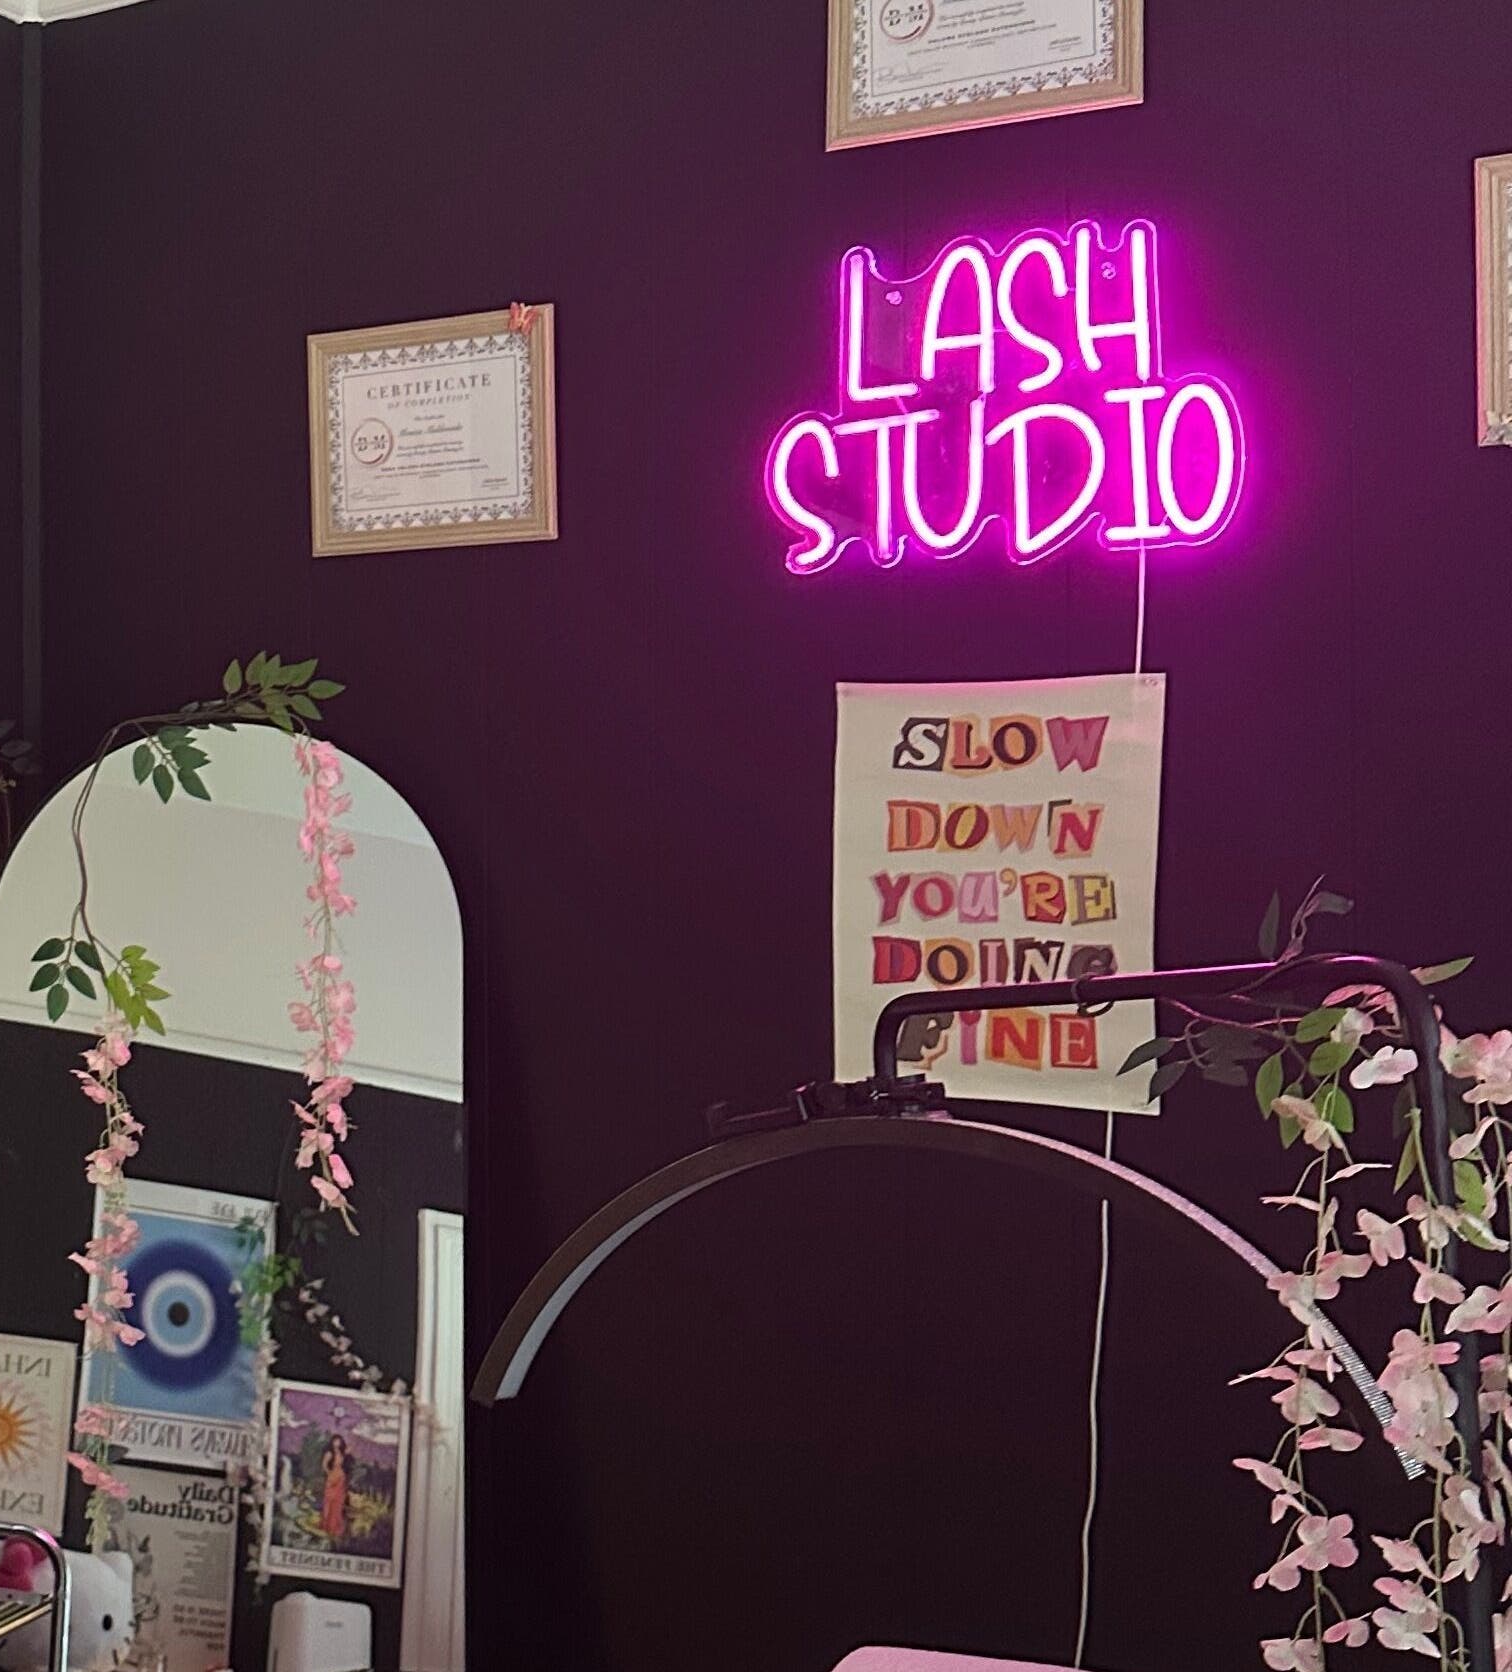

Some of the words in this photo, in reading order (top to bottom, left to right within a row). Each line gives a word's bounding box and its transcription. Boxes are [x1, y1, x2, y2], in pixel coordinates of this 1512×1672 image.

[848, 228, 1151, 401] LASH
[367, 373, 492, 400] CERTIFICATE
[773, 383, 1234, 566] STUDIO
[892, 715, 1110, 775] SLOW
[886, 800, 1105, 857] DOWN
[872, 868, 1117, 924] YOU'RE
